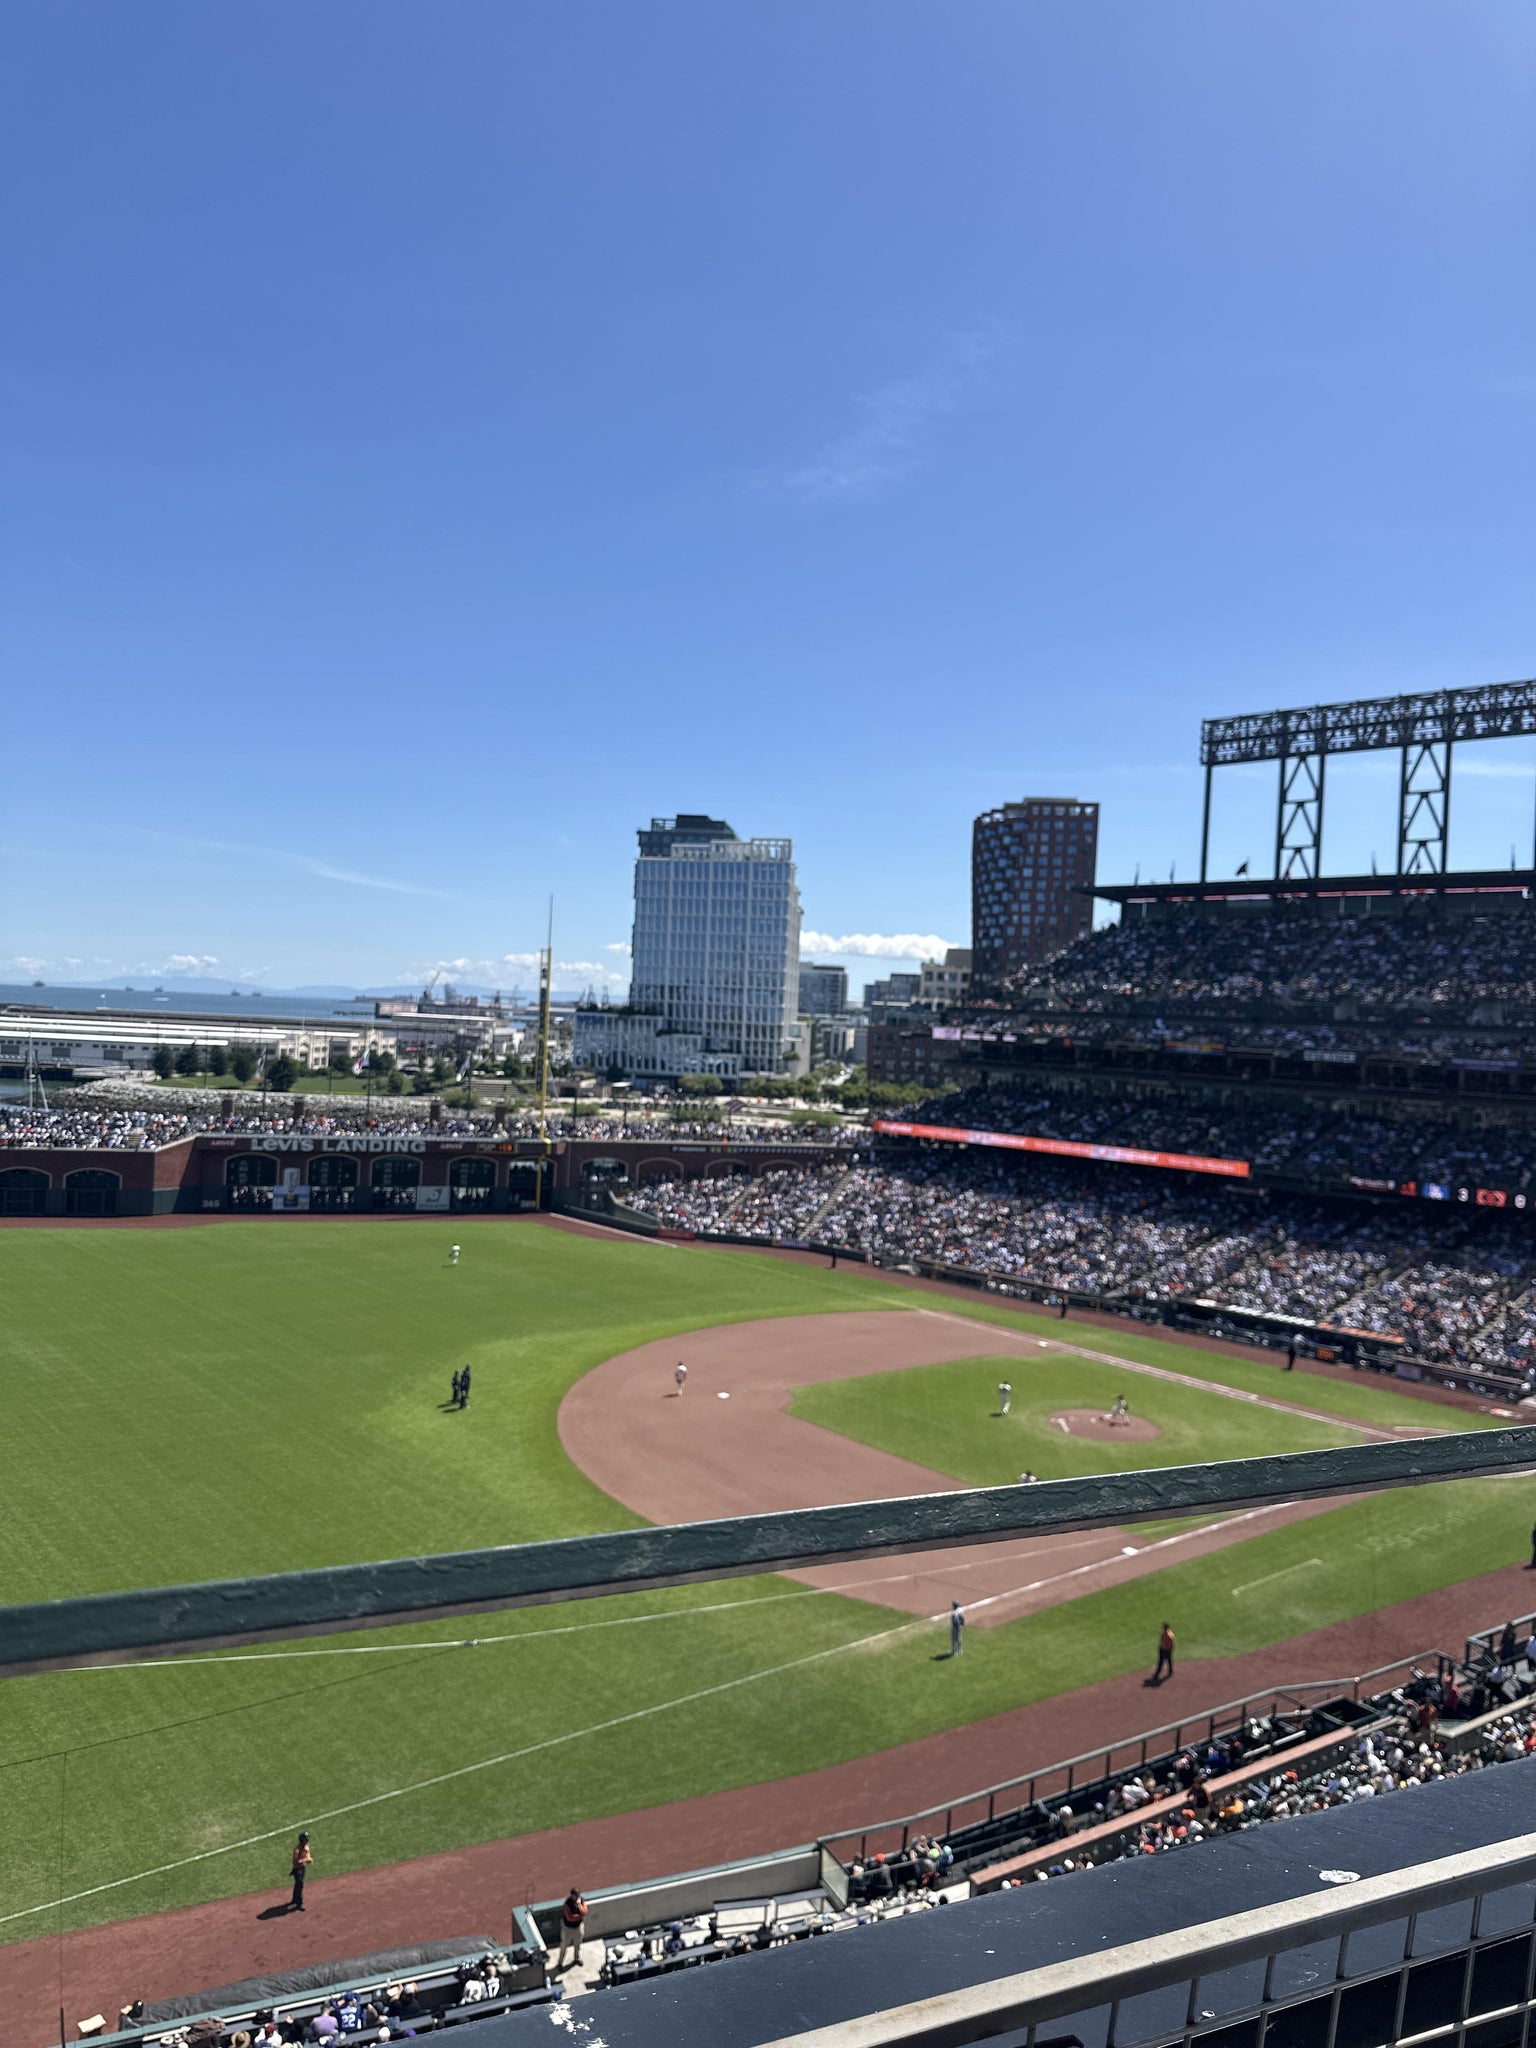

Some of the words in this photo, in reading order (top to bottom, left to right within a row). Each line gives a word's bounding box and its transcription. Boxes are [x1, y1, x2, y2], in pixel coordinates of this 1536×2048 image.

[322, 1139, 427, 1153] LANDING
[1458, 1187, 1469, 1202] 3
[341, 2013, 356, 2028] 22
